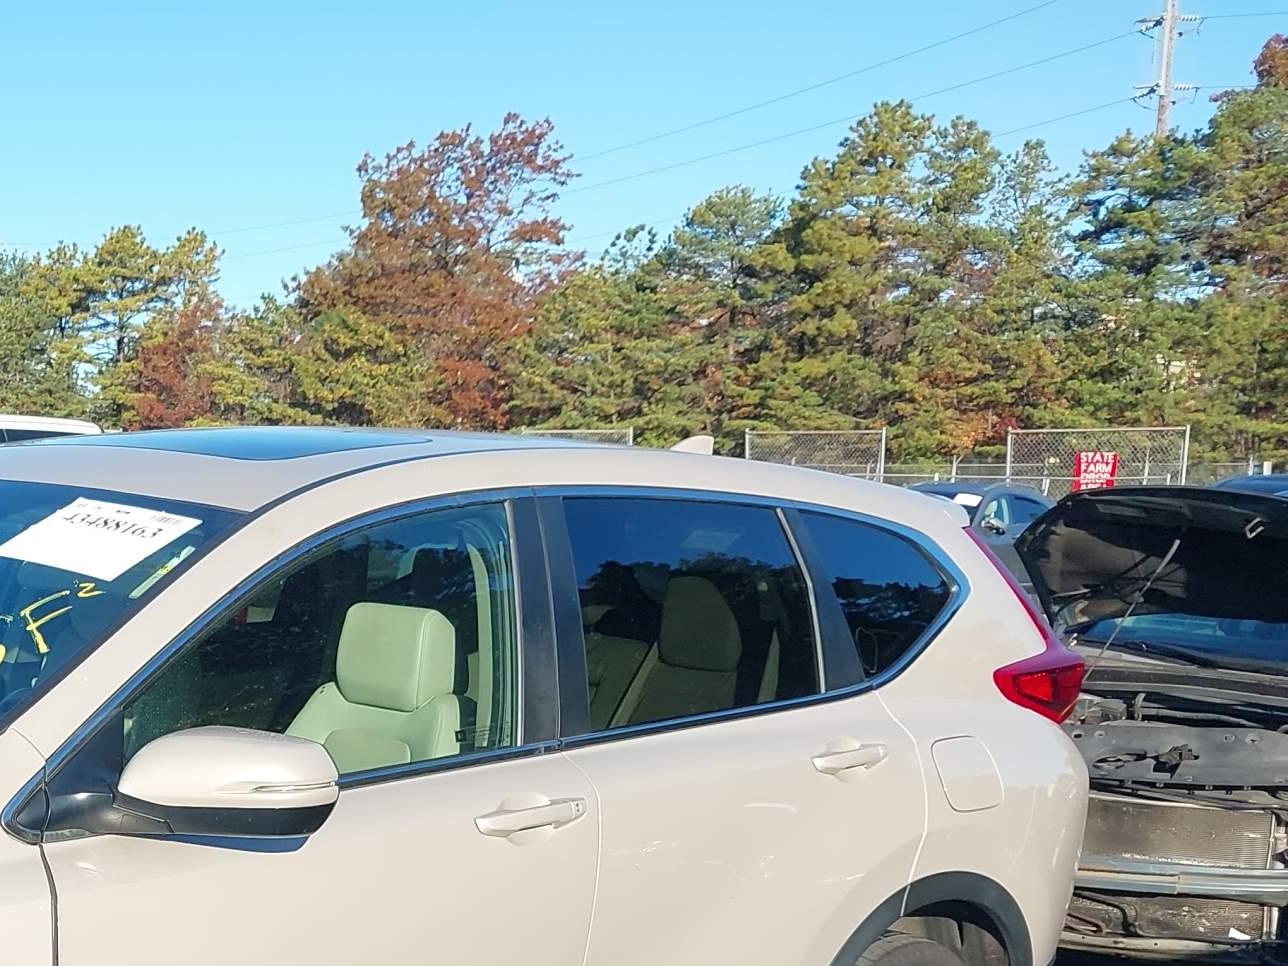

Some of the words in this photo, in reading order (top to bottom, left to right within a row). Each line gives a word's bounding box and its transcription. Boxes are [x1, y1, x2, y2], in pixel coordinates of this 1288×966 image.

[1080, 451, 1115, 463] STATE
[1080, 463, 1113, 473] FARM
[62, 511, 164, 539] 43488163
